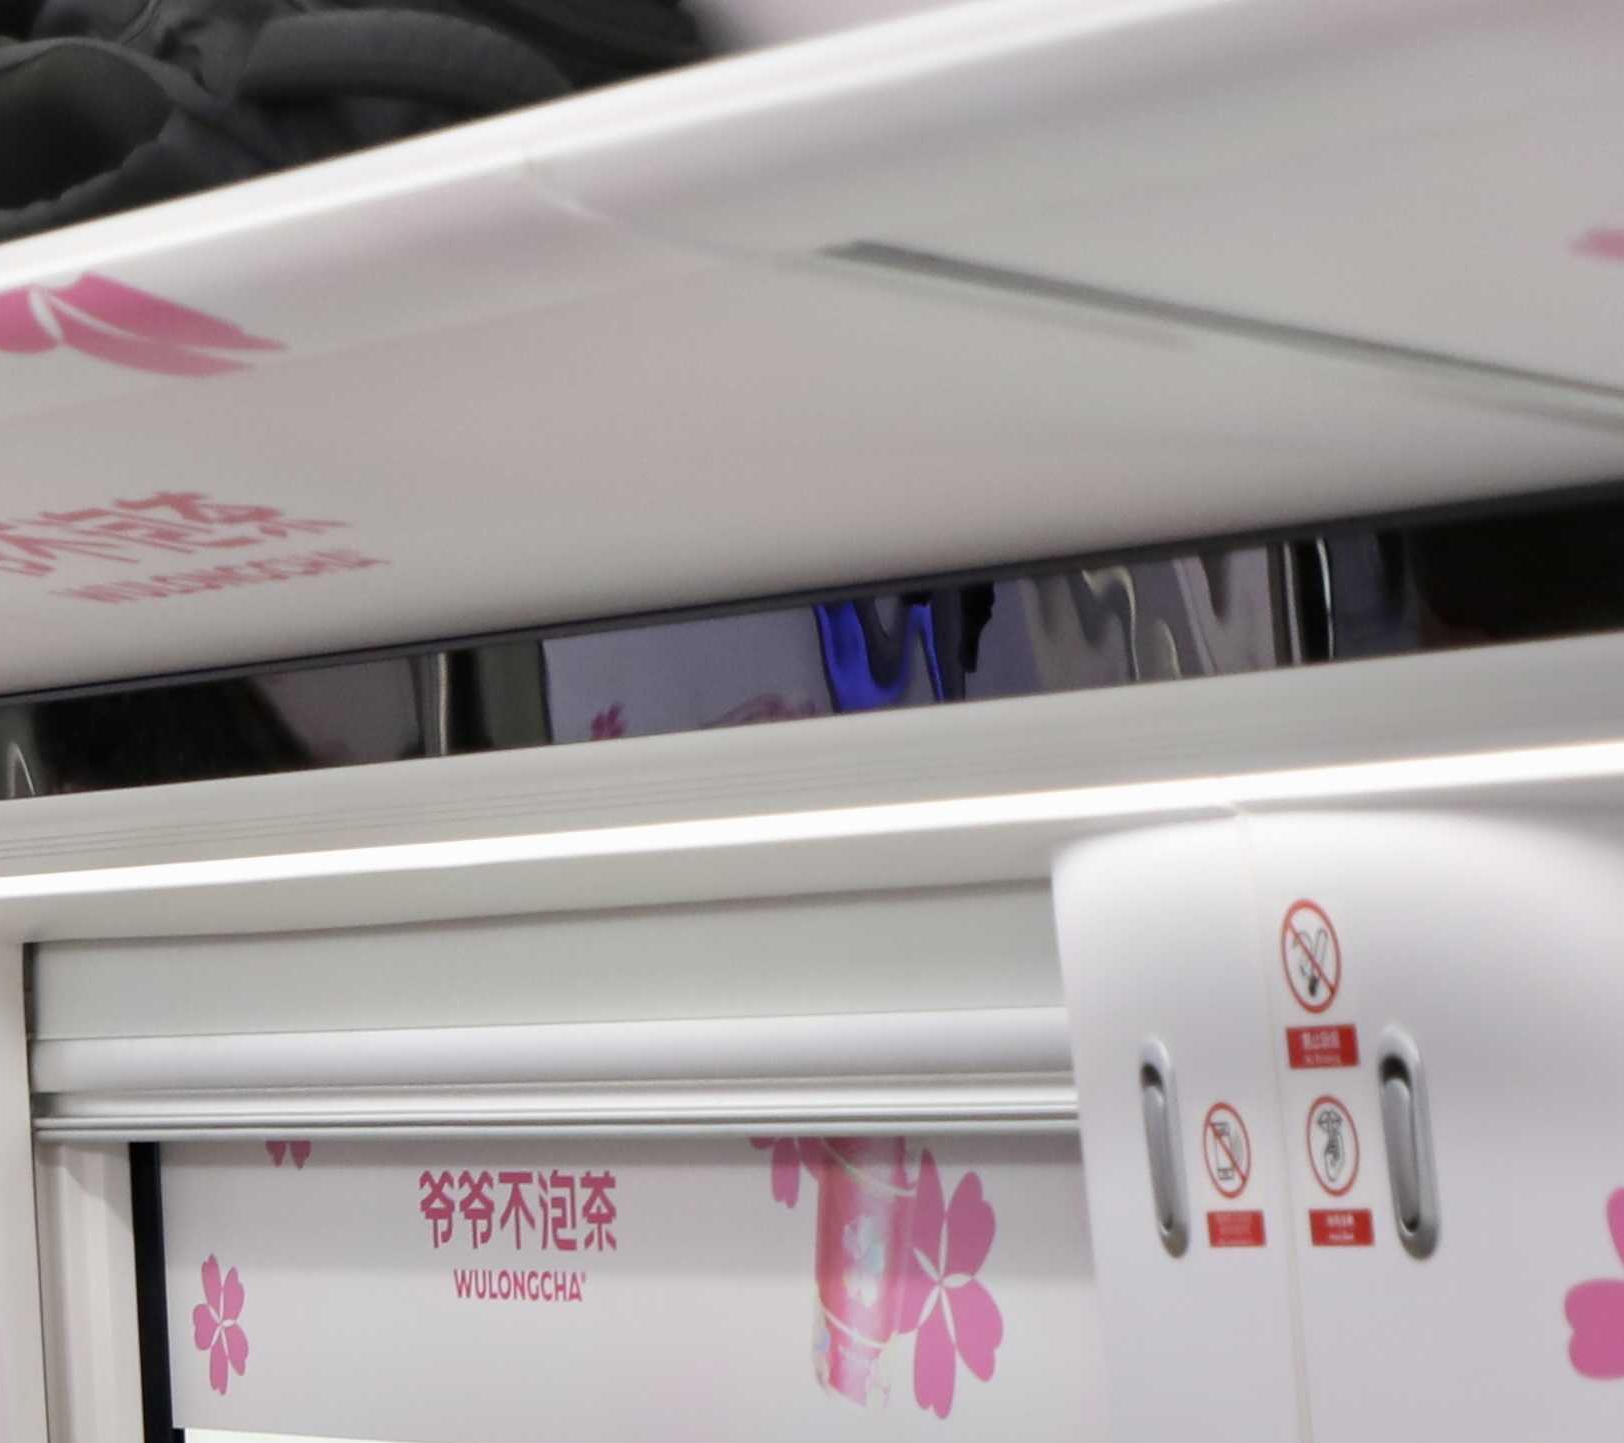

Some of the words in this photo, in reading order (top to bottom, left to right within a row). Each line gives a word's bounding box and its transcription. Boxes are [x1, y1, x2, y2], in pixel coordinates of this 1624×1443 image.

[419, 1168, 617, 1252] 爷爷不泡茶
